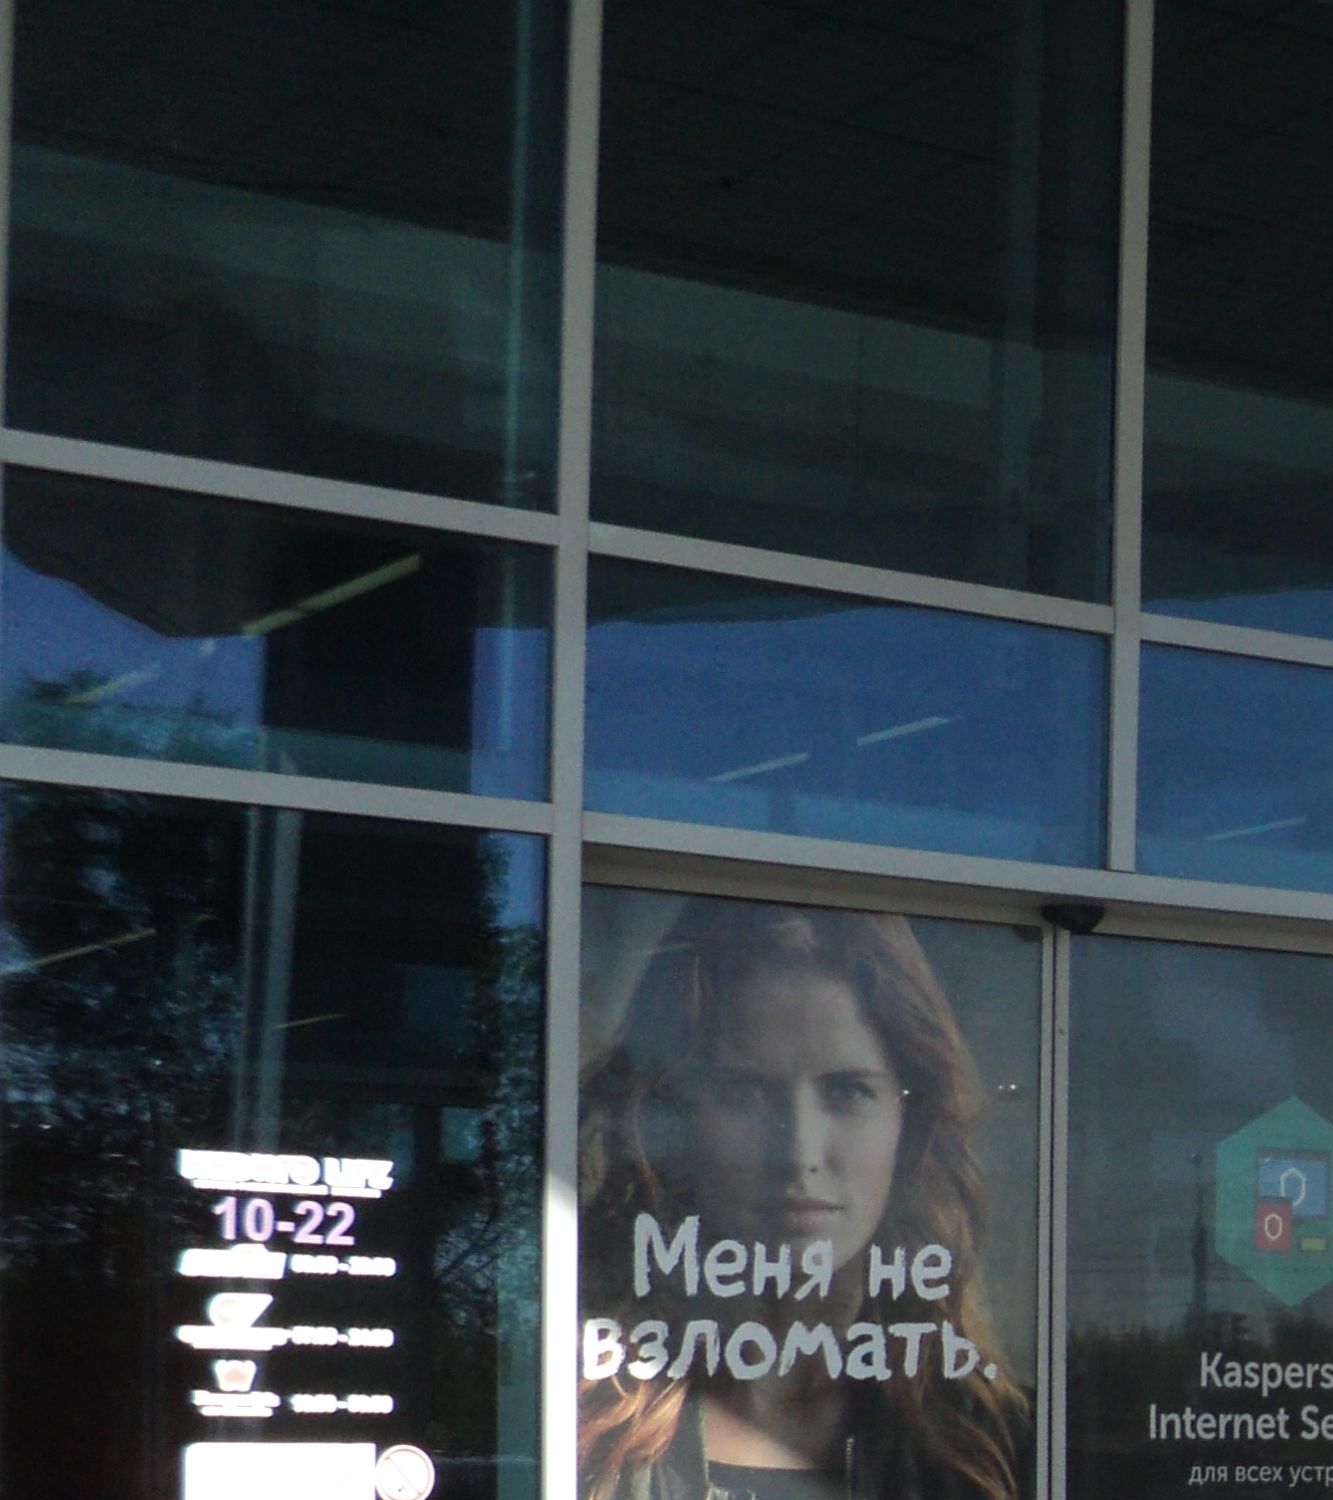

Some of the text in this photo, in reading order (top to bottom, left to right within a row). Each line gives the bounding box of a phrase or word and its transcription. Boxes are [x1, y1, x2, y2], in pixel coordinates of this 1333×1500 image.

[212, 1197, 355, 1245] 10-22
[633, 1213, 952, 1300] Меня не
[582, 1318, 998, 1381] взломать.
[1149, 1404, 1290, 1440] Internet
[1188, 1464, 1228, 1485] для
[1235, 1465, 1283, 1482] всех
